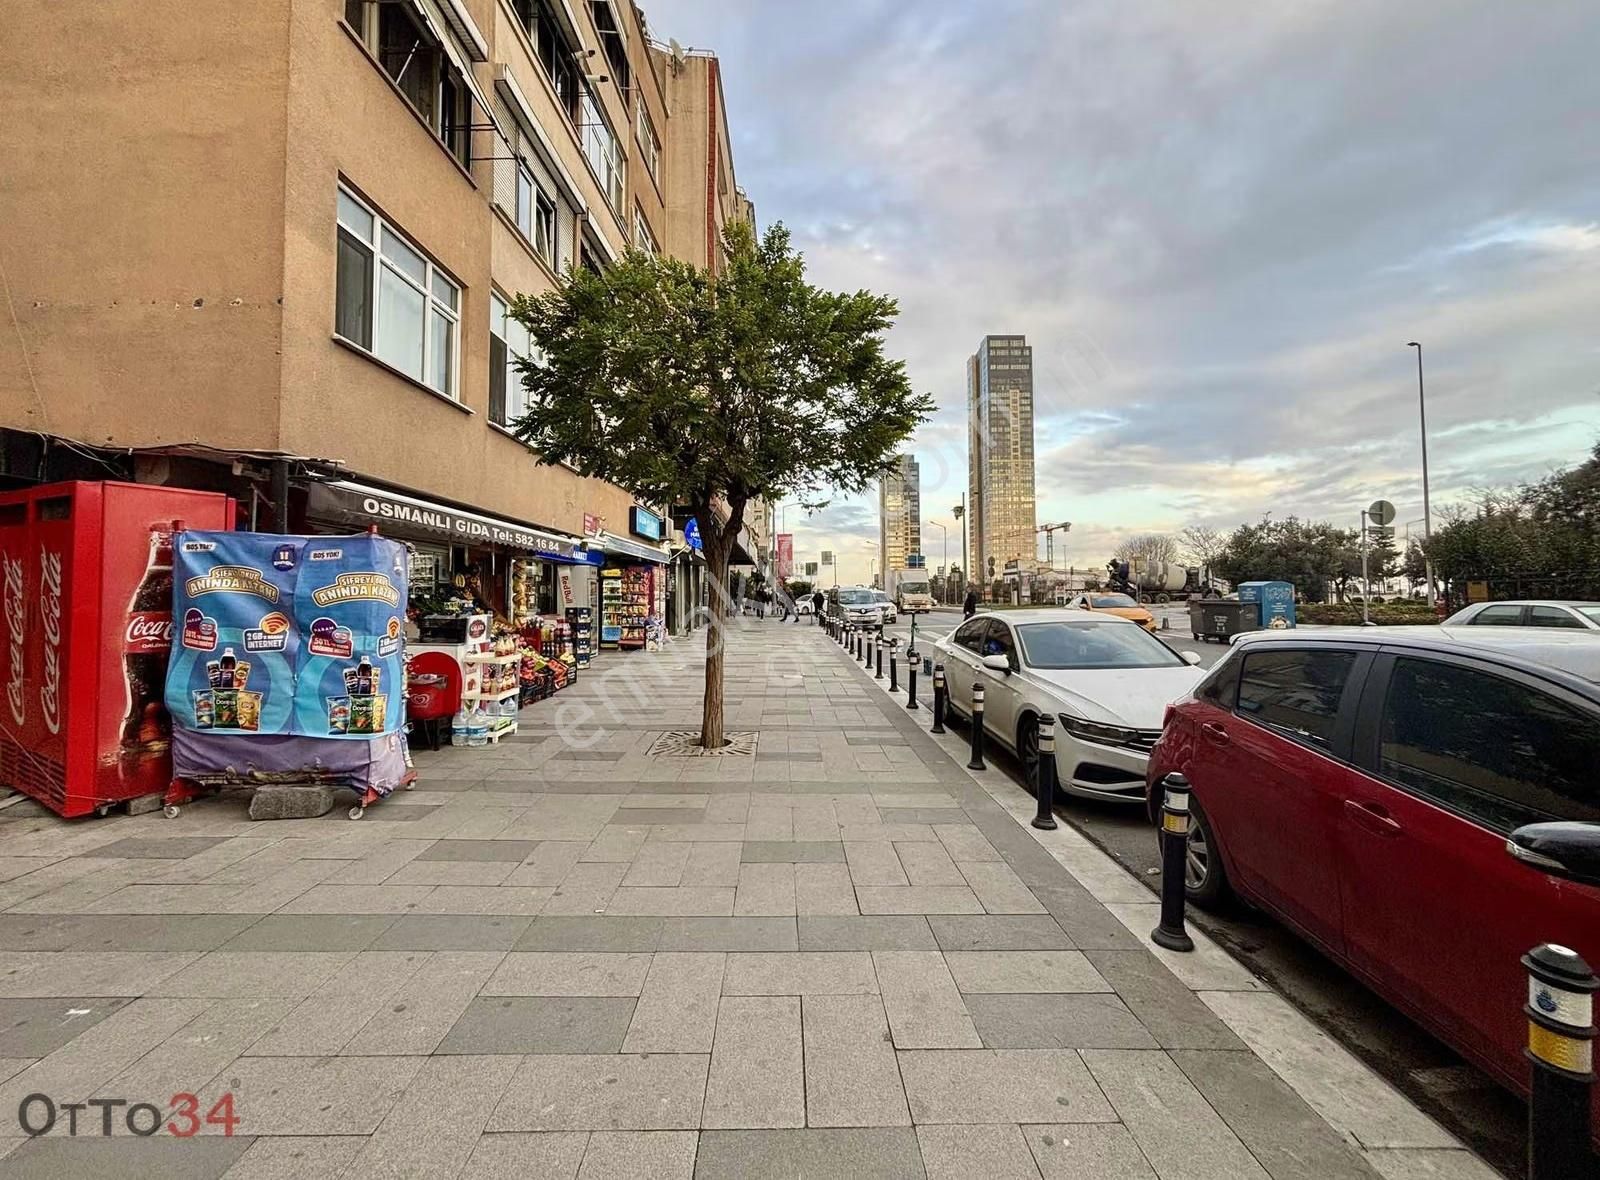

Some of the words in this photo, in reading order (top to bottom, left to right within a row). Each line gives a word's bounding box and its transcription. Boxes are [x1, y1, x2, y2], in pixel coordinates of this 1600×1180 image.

[364, 497, 450, 530] OSMANLI
[455, 518, 490, 538] GIDA
[492, 527, 514, 542] Tel:
[516, 532, 535, 546] 582
[536, 538, 547, 550] 16
[548, 540, 560, 552] 84
[190, 578, 240, 593] ANINDA
[318, 586, 368, 603] ANINDA
[2, 549, 26, 727] Coca-Cola
[40, 543, 62, 735] Coca-Cola
